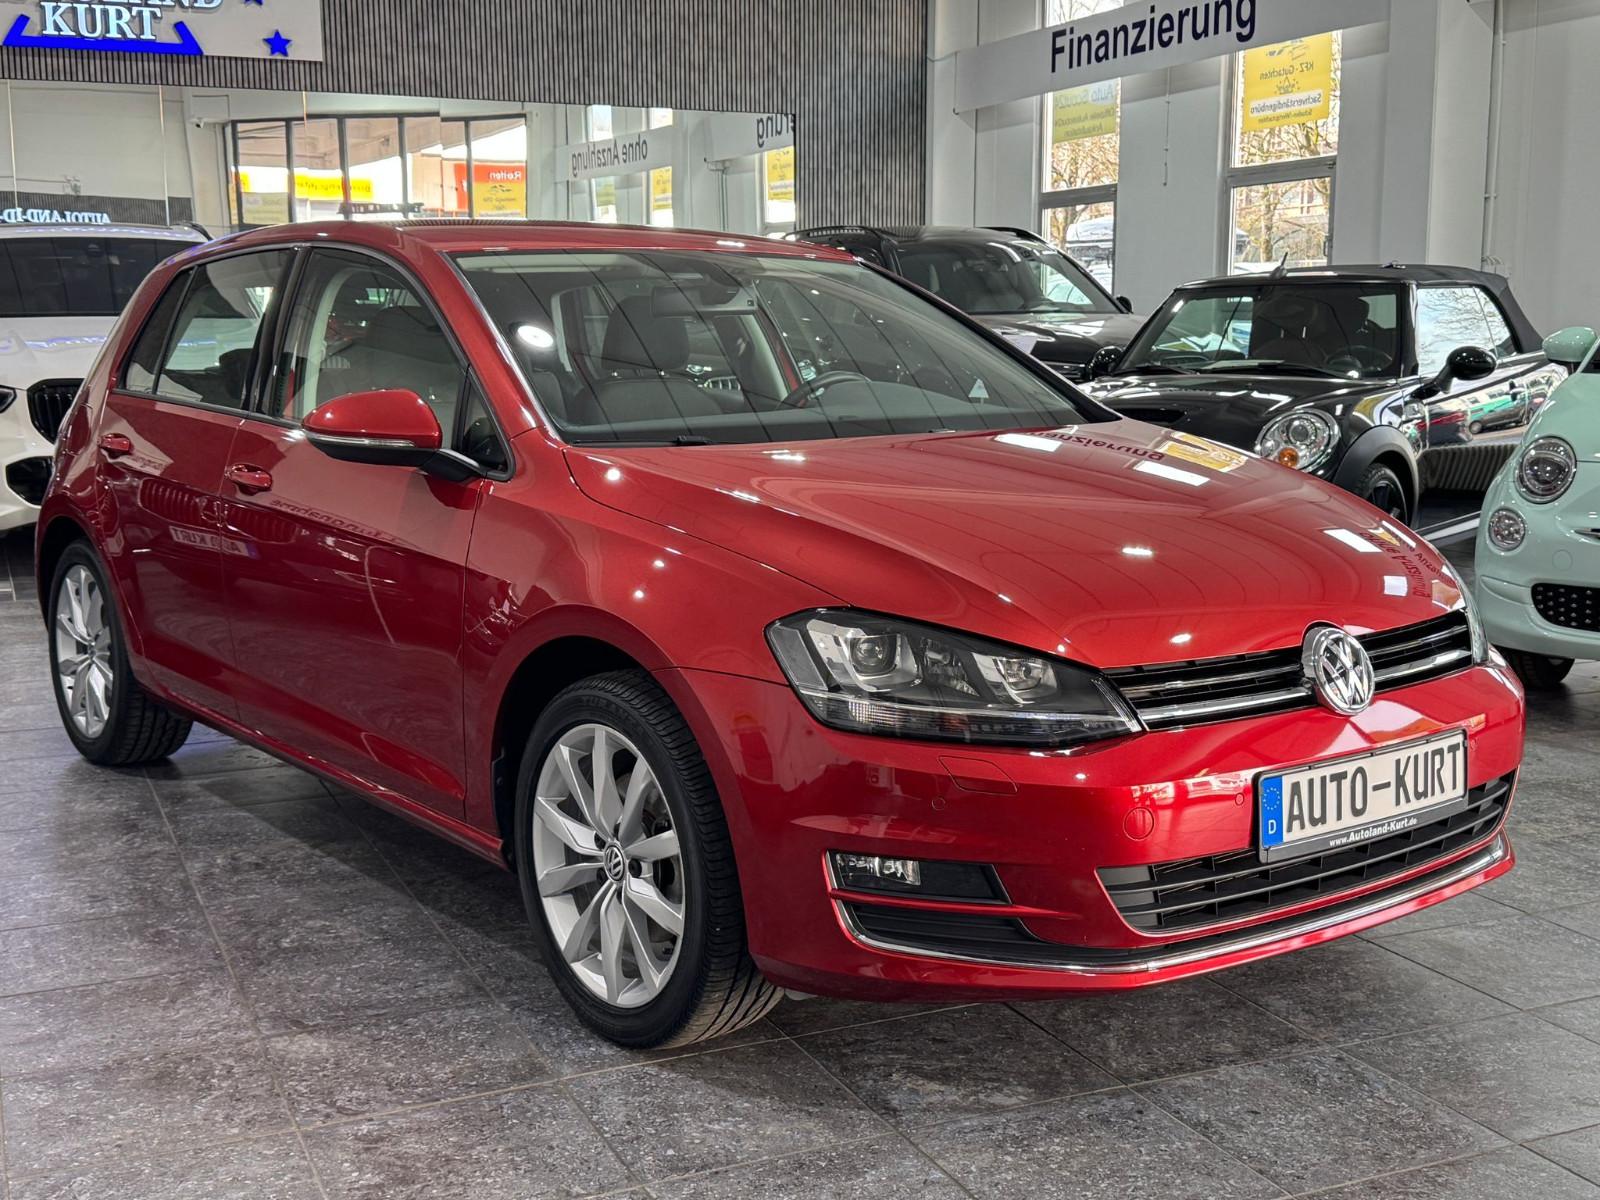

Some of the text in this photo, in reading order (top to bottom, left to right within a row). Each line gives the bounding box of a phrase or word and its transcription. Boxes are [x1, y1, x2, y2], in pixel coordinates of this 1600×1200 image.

[40, 1, 162, 40] KURT
[1051, 0, 1256, 73] Finanzierung
[1268, 742, 1461, 834] D AUTO-KURT
[1329, 817, 1418, 847] www.Autoland-Kurt.de
